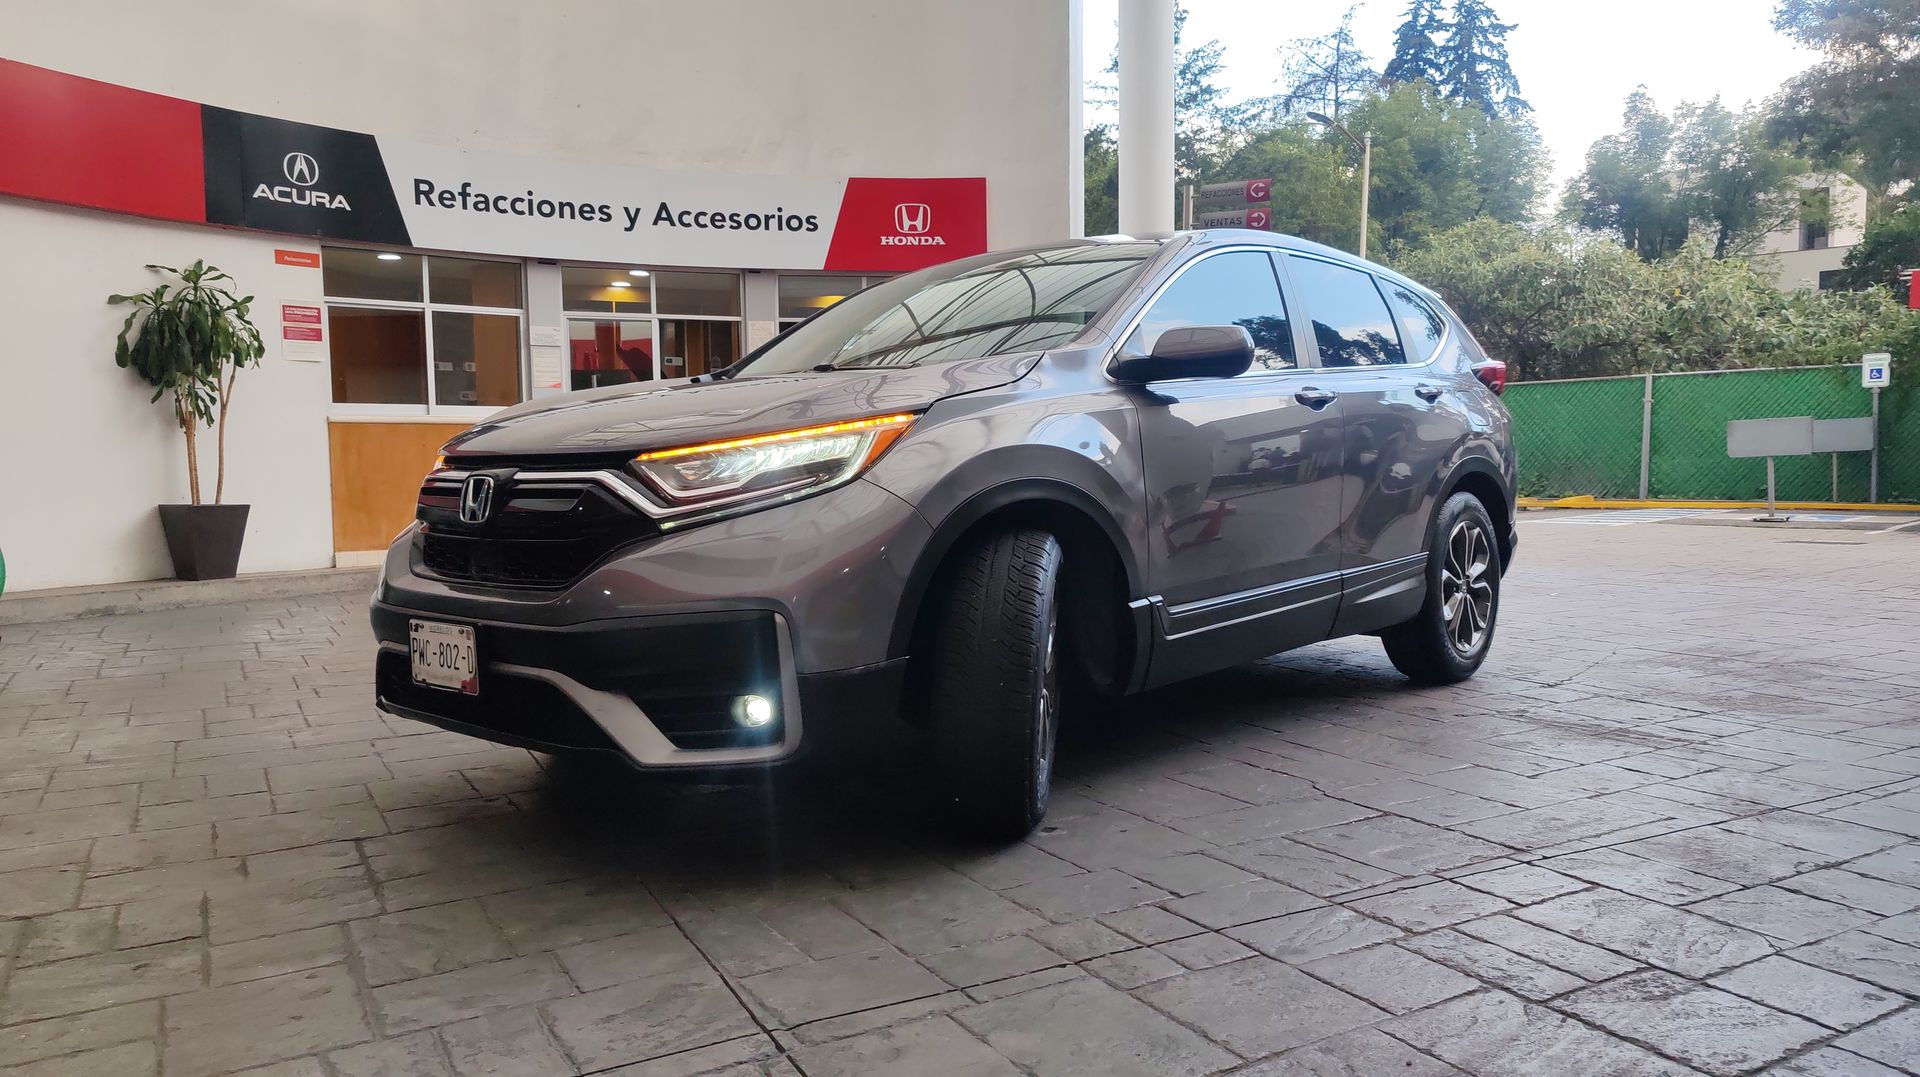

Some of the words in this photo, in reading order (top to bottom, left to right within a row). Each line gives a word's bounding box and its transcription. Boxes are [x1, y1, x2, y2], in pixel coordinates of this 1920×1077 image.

[252, 183, 352, 211] ACURA
[1200, 187, 1245, 199] REFACCIONES
[413, 177, 613, 223] Refacciones
[622, 206, 642, 232] y
[651, 201, 819, 233] Accesorios
[1203, 216, 1243, 227] VENTAS
[880, 235, 946, 246] HONDA
[411, 637, 474, 674] PWC-802-D
